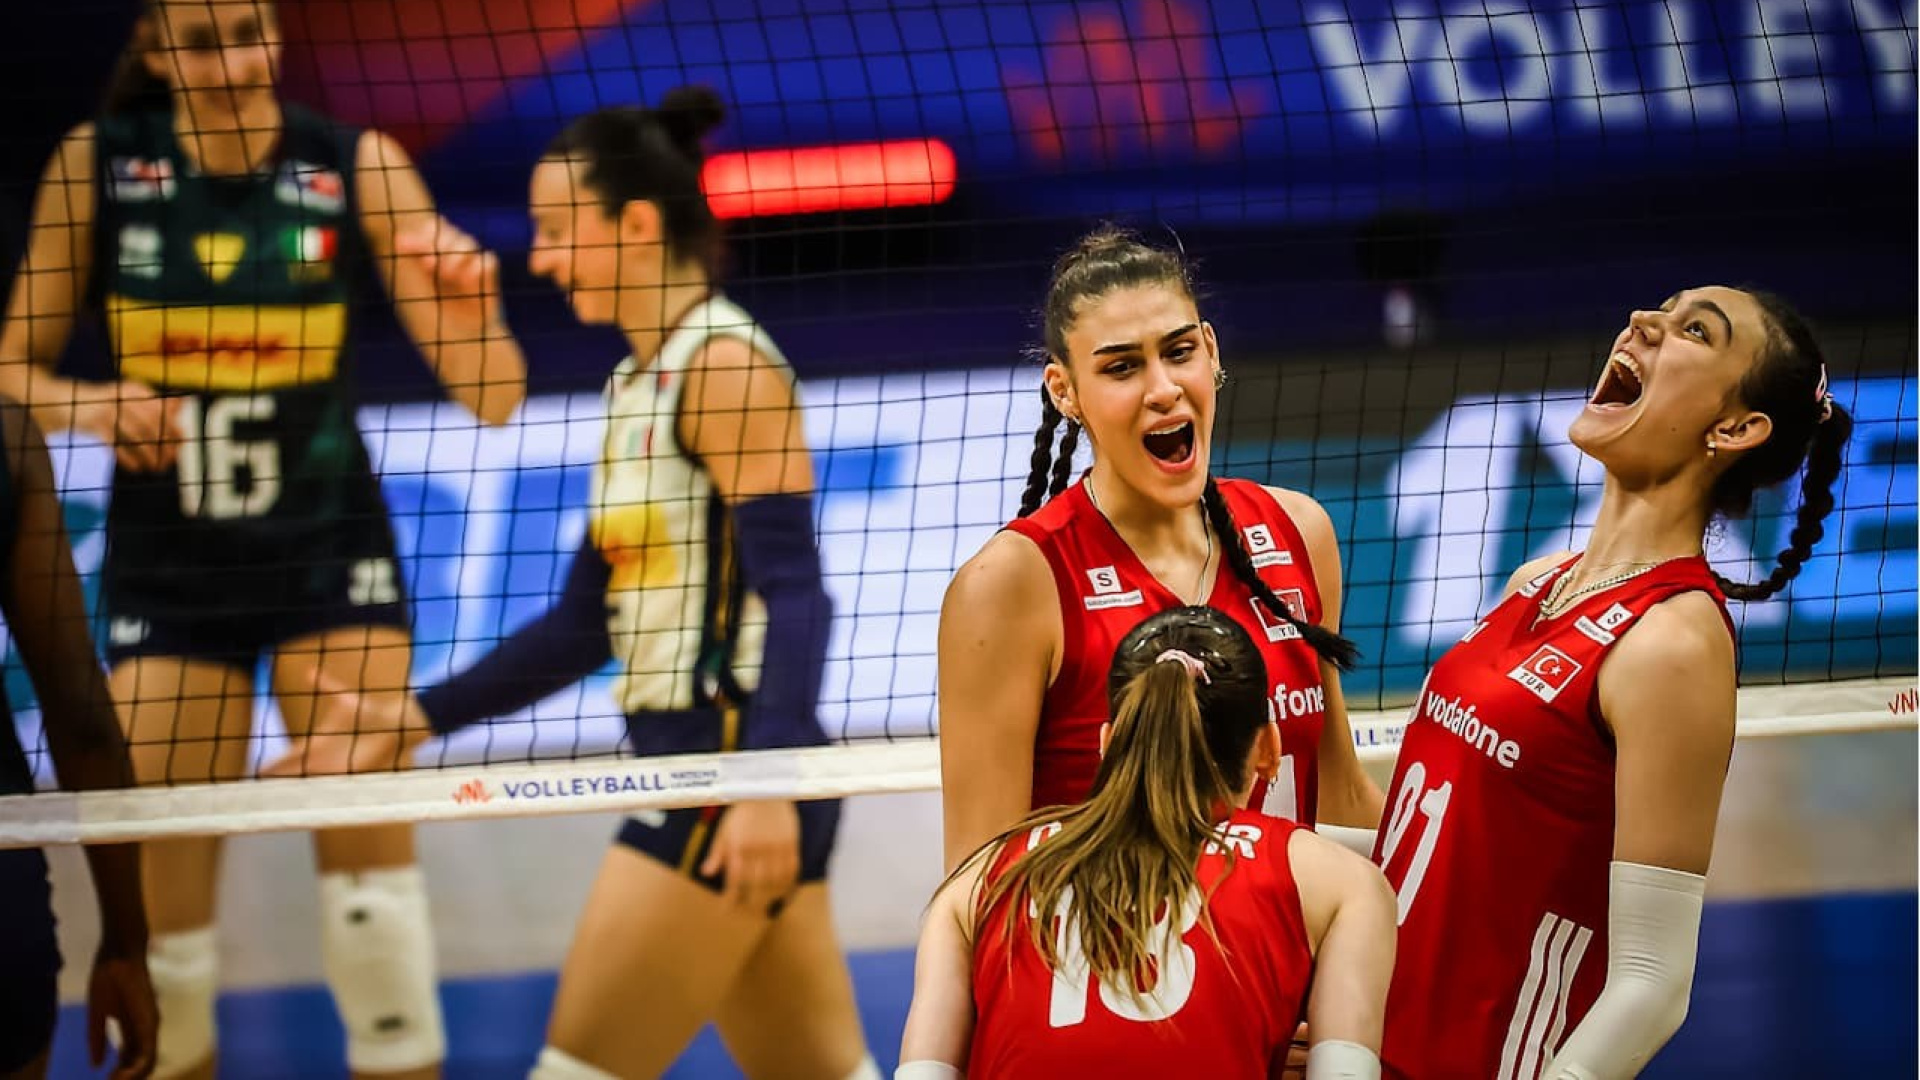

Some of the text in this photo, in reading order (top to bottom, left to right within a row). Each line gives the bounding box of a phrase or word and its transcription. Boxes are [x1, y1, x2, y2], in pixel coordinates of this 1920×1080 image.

[177, 393, 283, 520] 16
[1518, 671, 1546, 693] TUR
[1267, 683, 1325, 721] fone
[1425, 690, 1521, 769] vodafone
[503, 773, 666, 799] VOLLEYBALL
